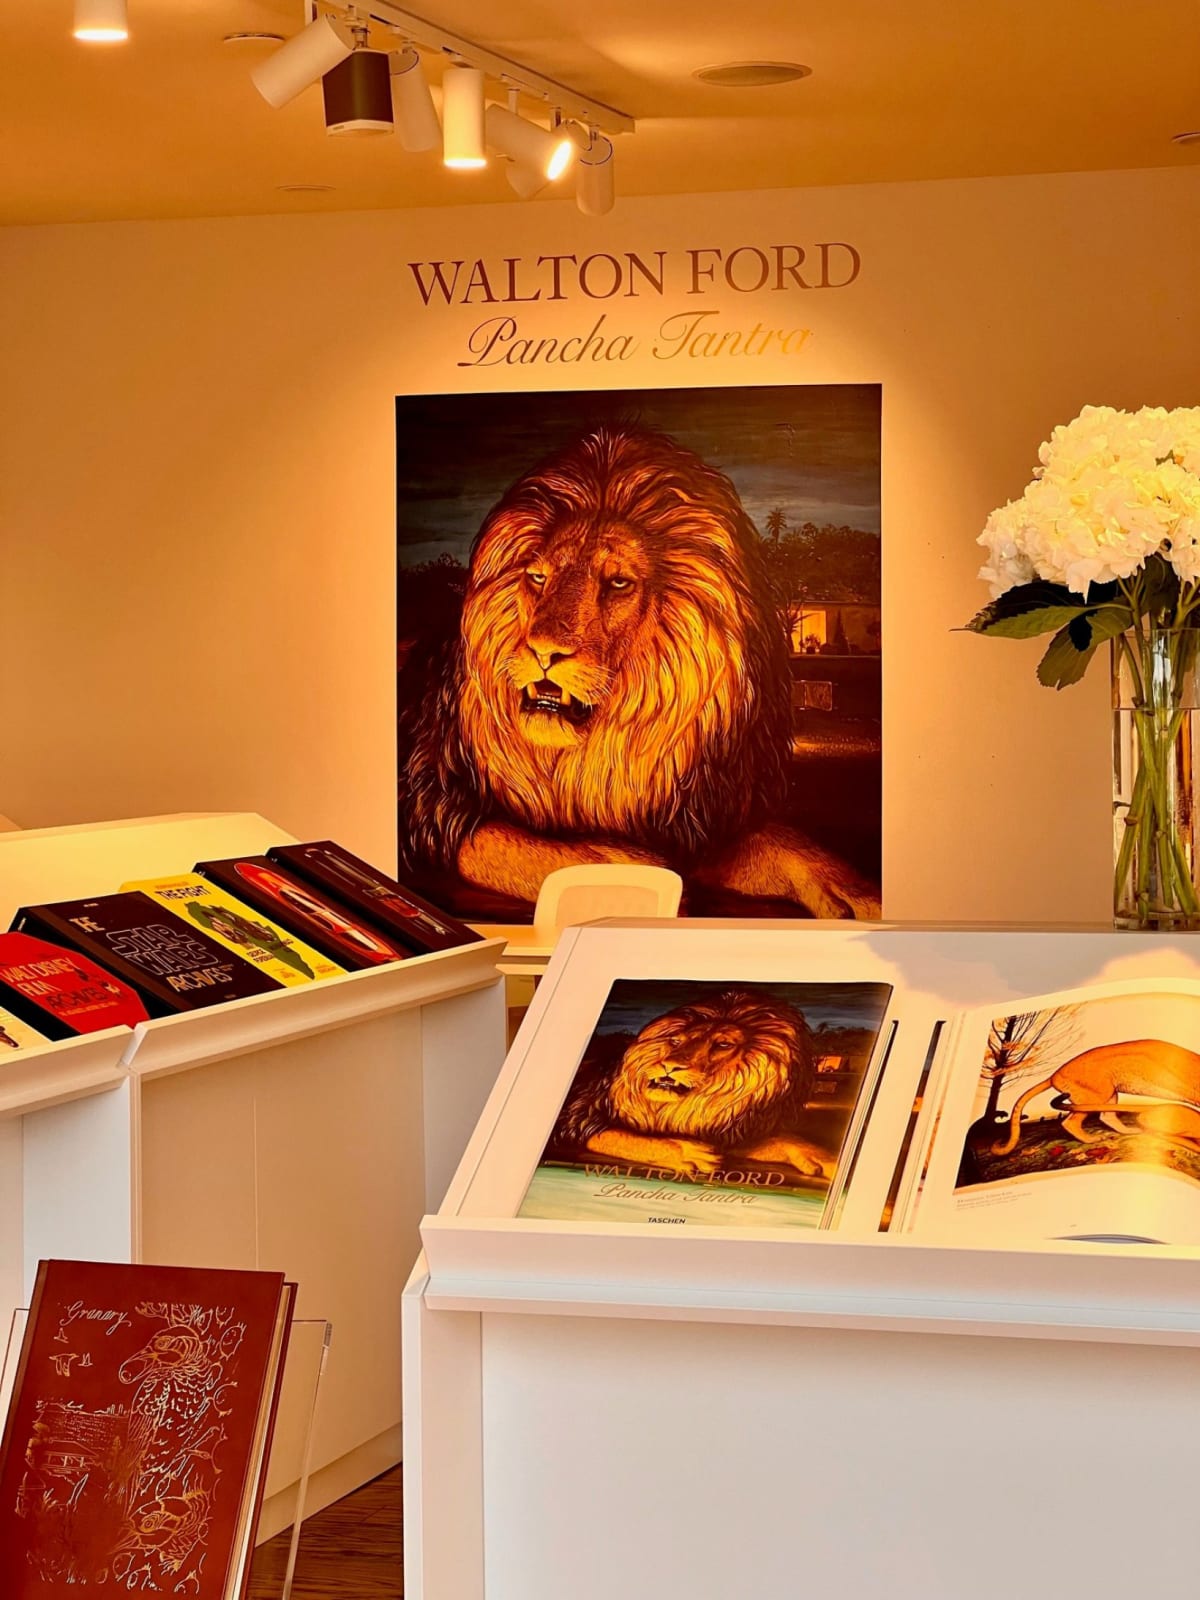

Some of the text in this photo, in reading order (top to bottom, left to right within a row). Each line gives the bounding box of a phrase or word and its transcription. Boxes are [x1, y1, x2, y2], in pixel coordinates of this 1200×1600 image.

[406, 242, 862, 306] WALTON FORD
[457, 310, 815, 367] Pancha Tantra
[154, 888, 184, 901] THE
[176, 885, 212, 898] FIGHT
[69, 916, 105, 933] THE
[106, 923, 192, 956] STAR
[0, 957, 81, 983] WALT DISNEY
[125, 942, 219, 976] WARS
[17, 980, 62, 996] FILM
[166, 966, 233, 992] ARCHIVES
[584, 1163, 786, 1187] WALTON FORD
[593, 1182, 760, 1204] Pancha Tantra
[647, 1217, 687, 1225] TASCHEN
